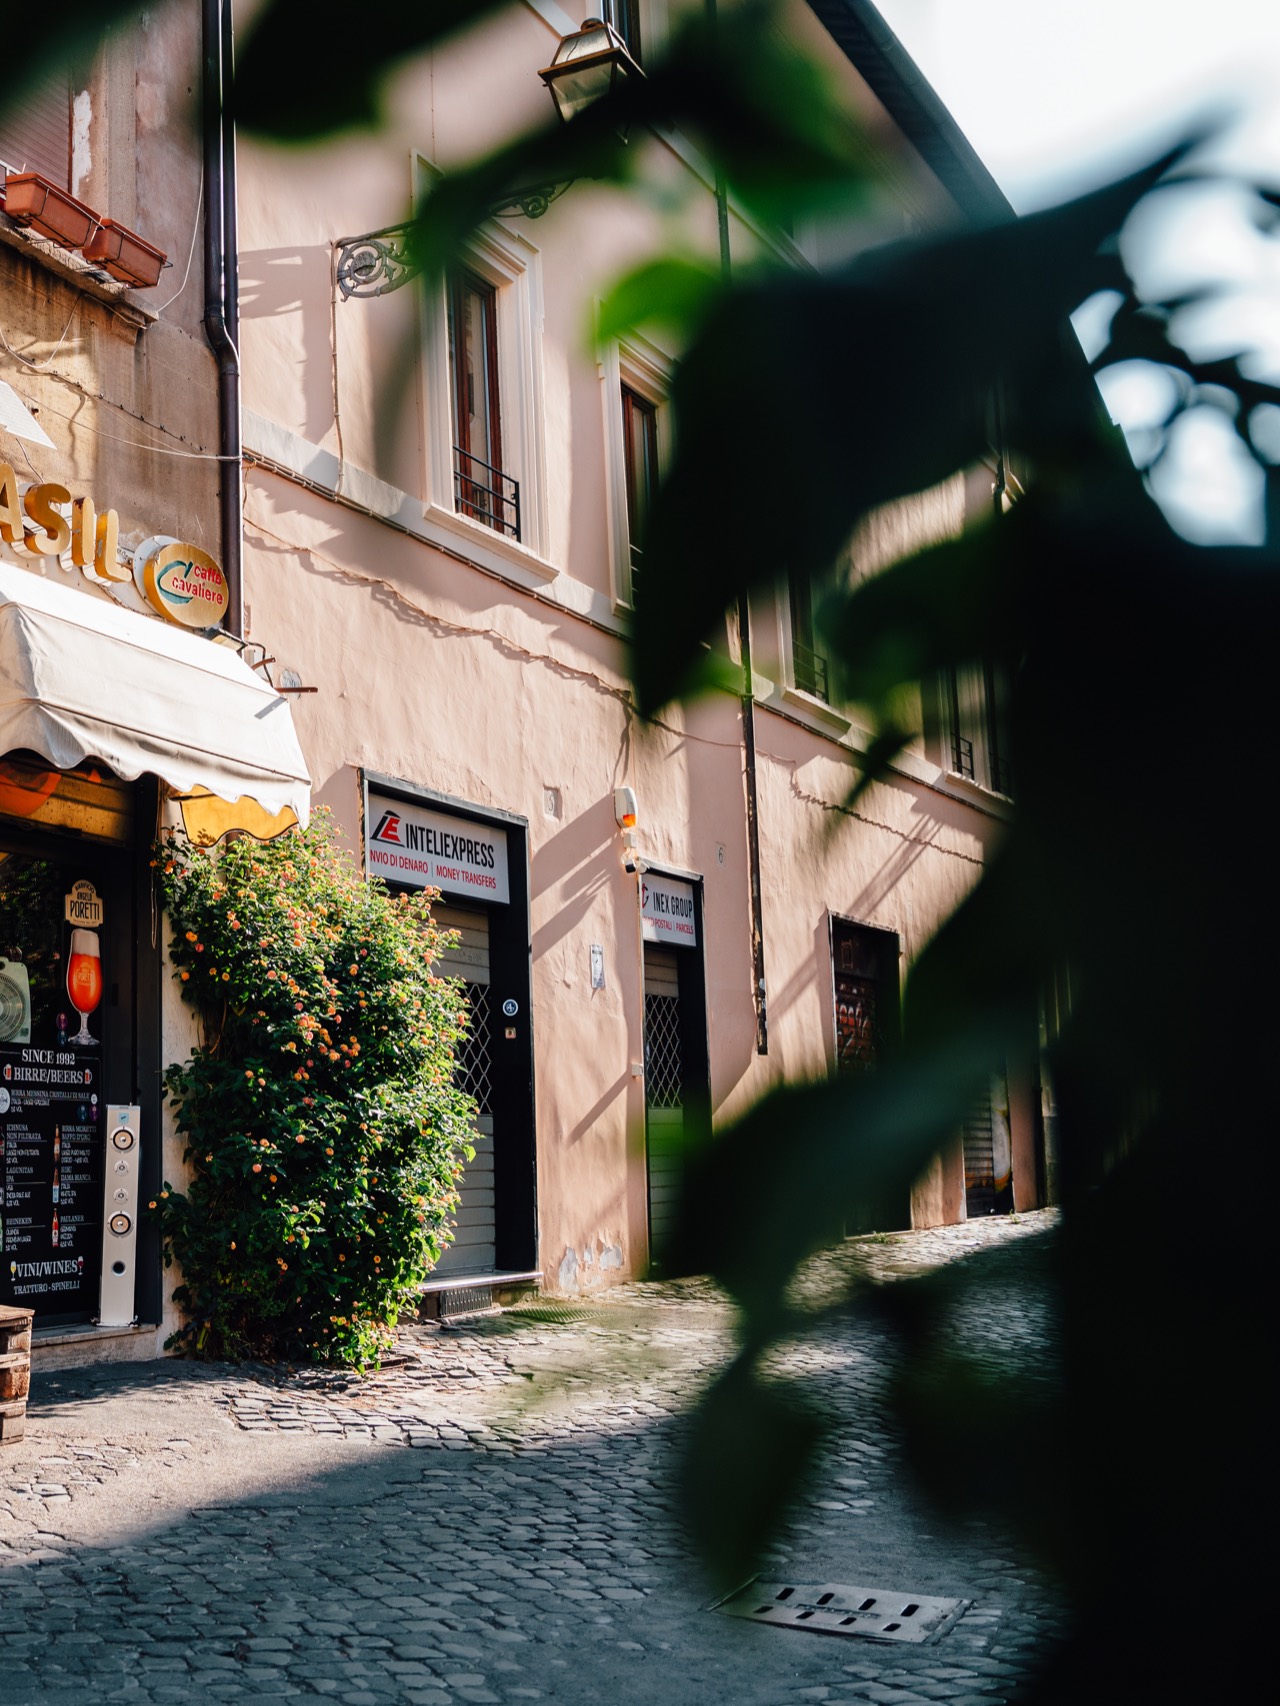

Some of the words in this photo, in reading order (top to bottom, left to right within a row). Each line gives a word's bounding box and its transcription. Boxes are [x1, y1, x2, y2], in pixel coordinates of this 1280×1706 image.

[171, 577, 223, 605] cavaliere
[405, 823, 495, 870] INTELIEXPRESS
[718, 847, 724, 864] 6
[390, 854, 398, 867] DI
[399, 856, 428, 874] DENARO
[436, 865, 460, 881] MONEY
[461, 871, 497, 889] TRANSFERS
[70, 900, 100, 920] PORETTI
[653, 892, 670, 914] INEX
[670, 896, 693, 919] GROUP
[654, 918, 673, 931] POSTALI
[675, 922, 694, 935] PARCELS
[21, 1048, 55, 1064] SINCE
[56, 1053, 76, 1066] 1992
[13, 1066, 84, 1084] BIRRE/BEERS
[26, 1089, 49, 1098] MESSINA
[6, 1124, 29, 1132] ICHNUSA
[6, 1132, 18, 1140] NON
[18, 1132, 42, 1140] FILTRATA
[6, 1166, 34, 1174] LAGUNITAS
[5, 1217, 32, 1226] HEINEKEN
[60, 1215, 85, 1223] PAULANER
[16, 1259, 78, 1278] VINI/WINES
[13, 1282, 48, 1295] TRATTURO
[51, 1280, 80, 1291] SPINELLI
